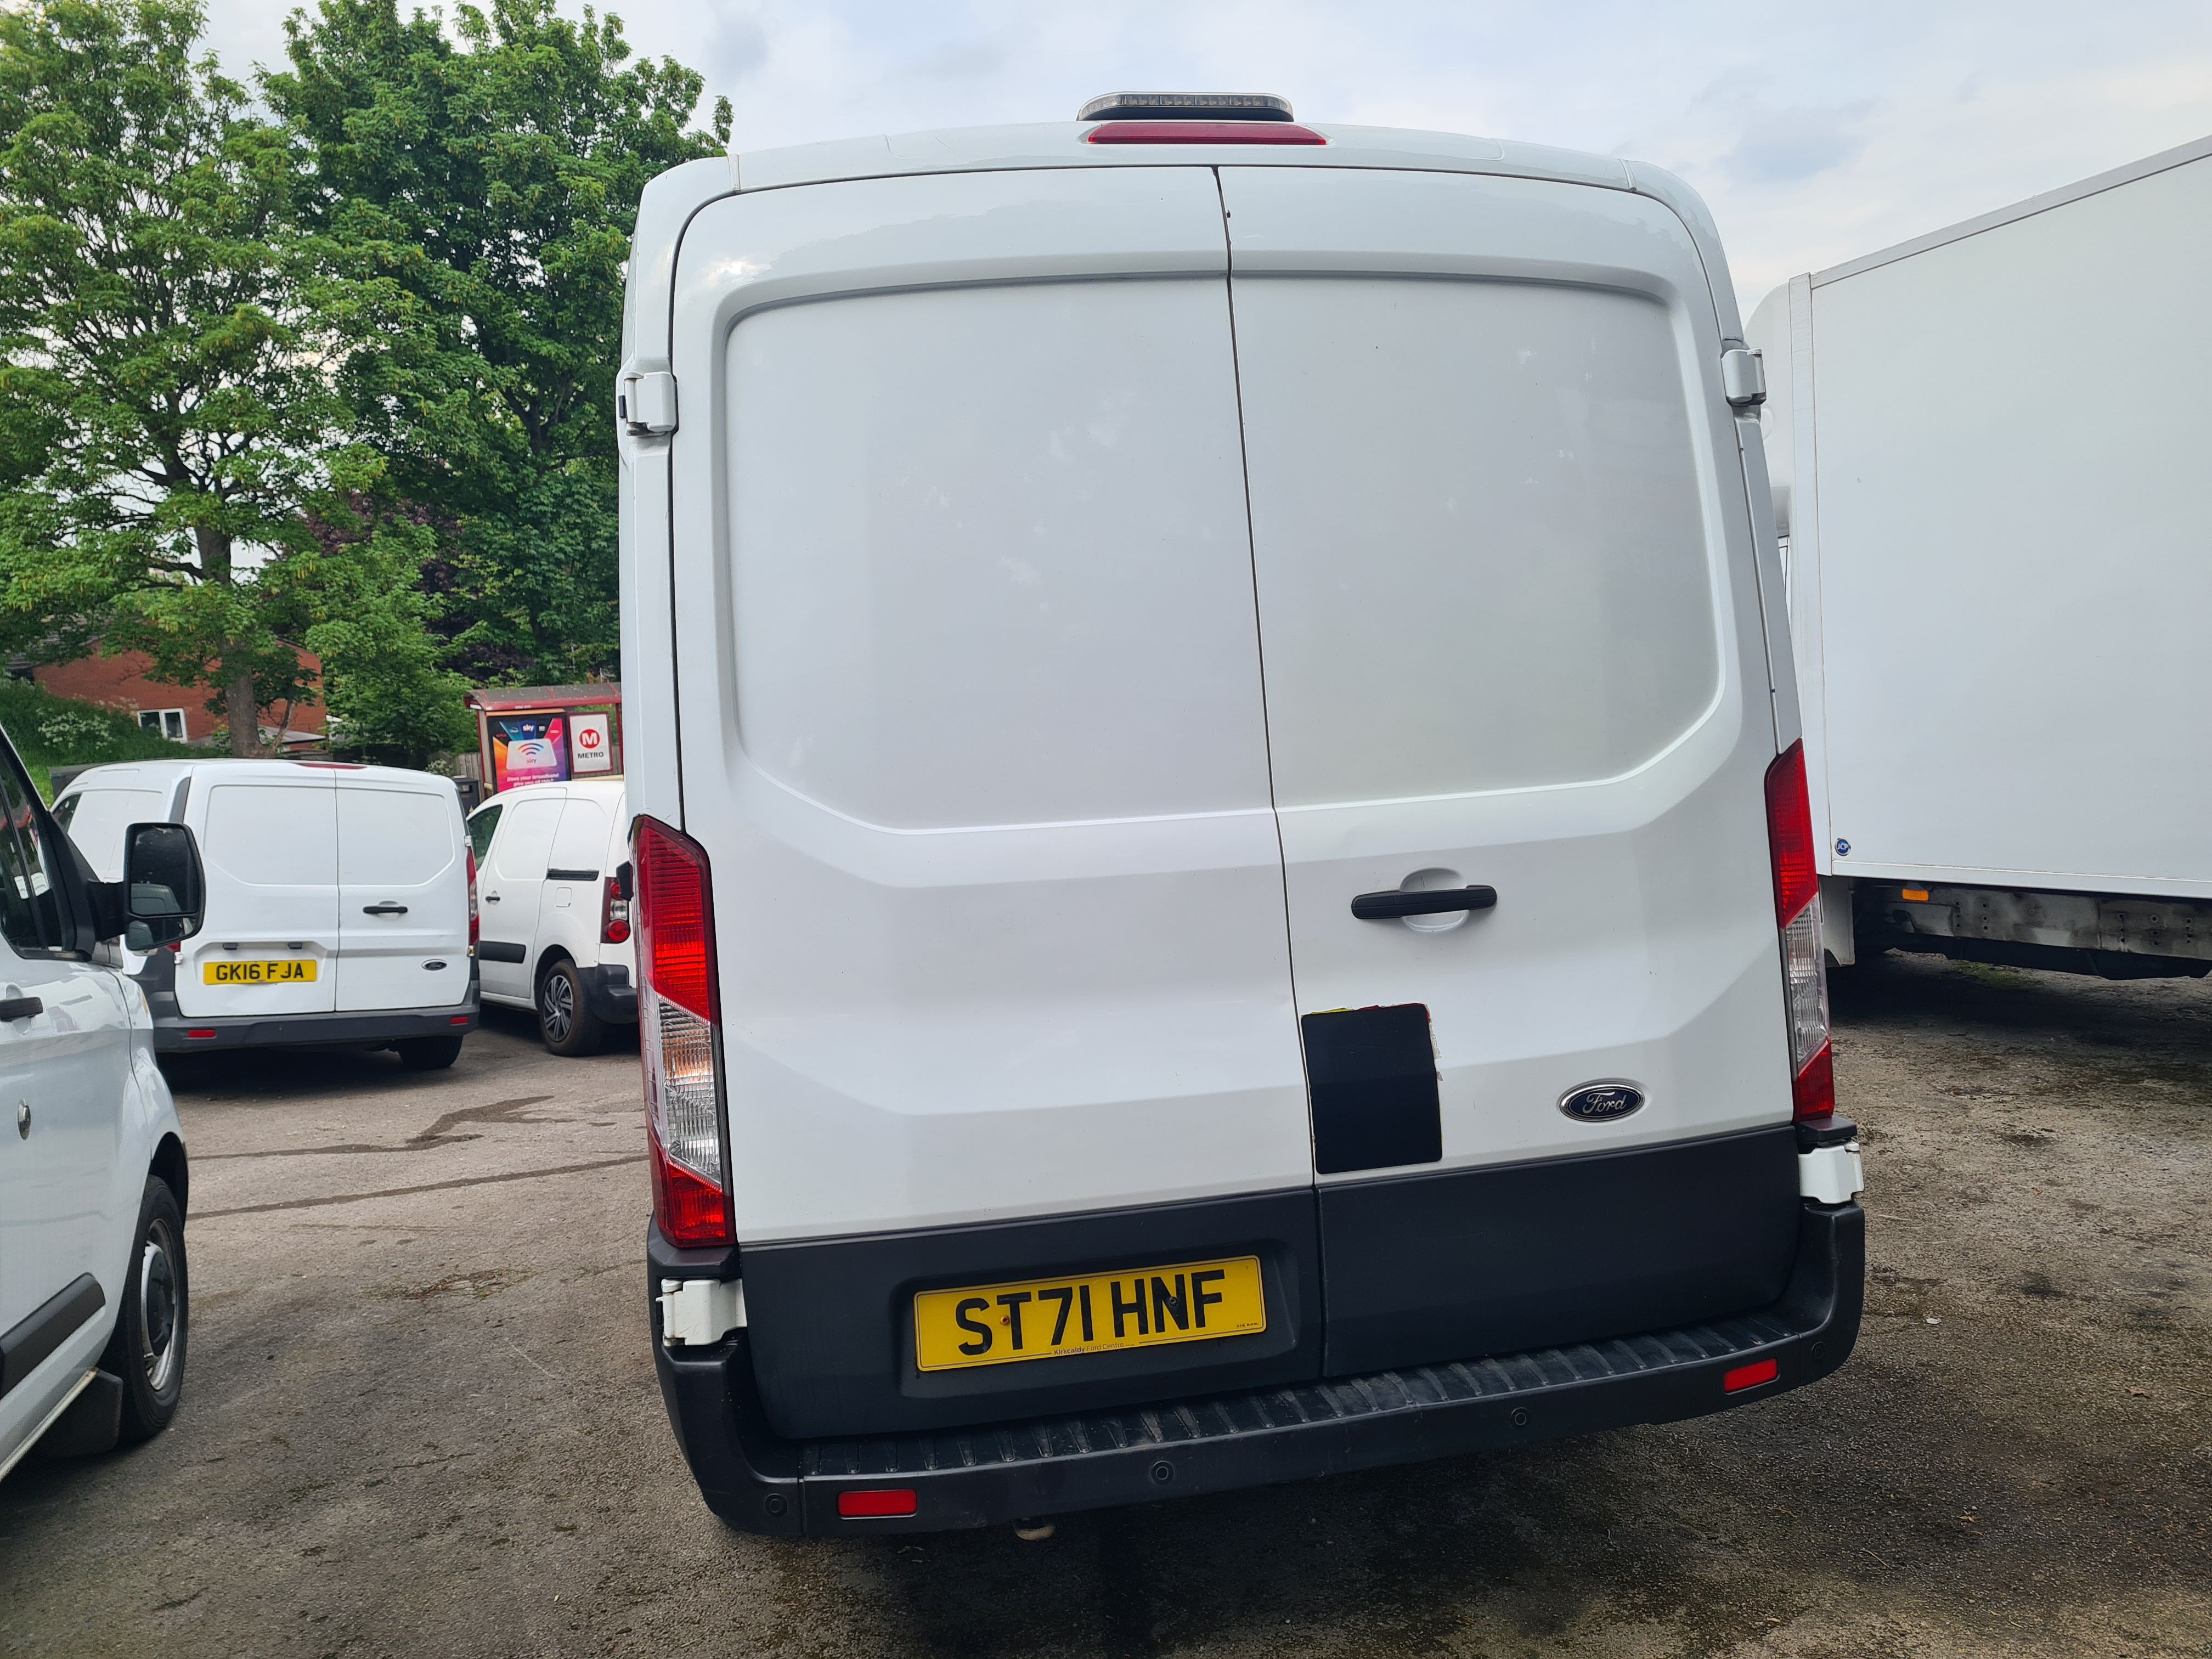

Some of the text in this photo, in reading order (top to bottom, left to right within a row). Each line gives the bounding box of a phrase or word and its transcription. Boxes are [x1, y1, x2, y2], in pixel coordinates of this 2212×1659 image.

[522, 724, 534, 732] sky
[582, 732, 597, 746] M
[577, 751, 604, 759] METRO
[216, 963, 304, 980] GK16 FJA
[1582, 1091, 1627, 1114] Ford
[955, 1269, 1226, 1356] ST71 HNF
[1053, 1346, 1085, 1356] Kirkcaldy
